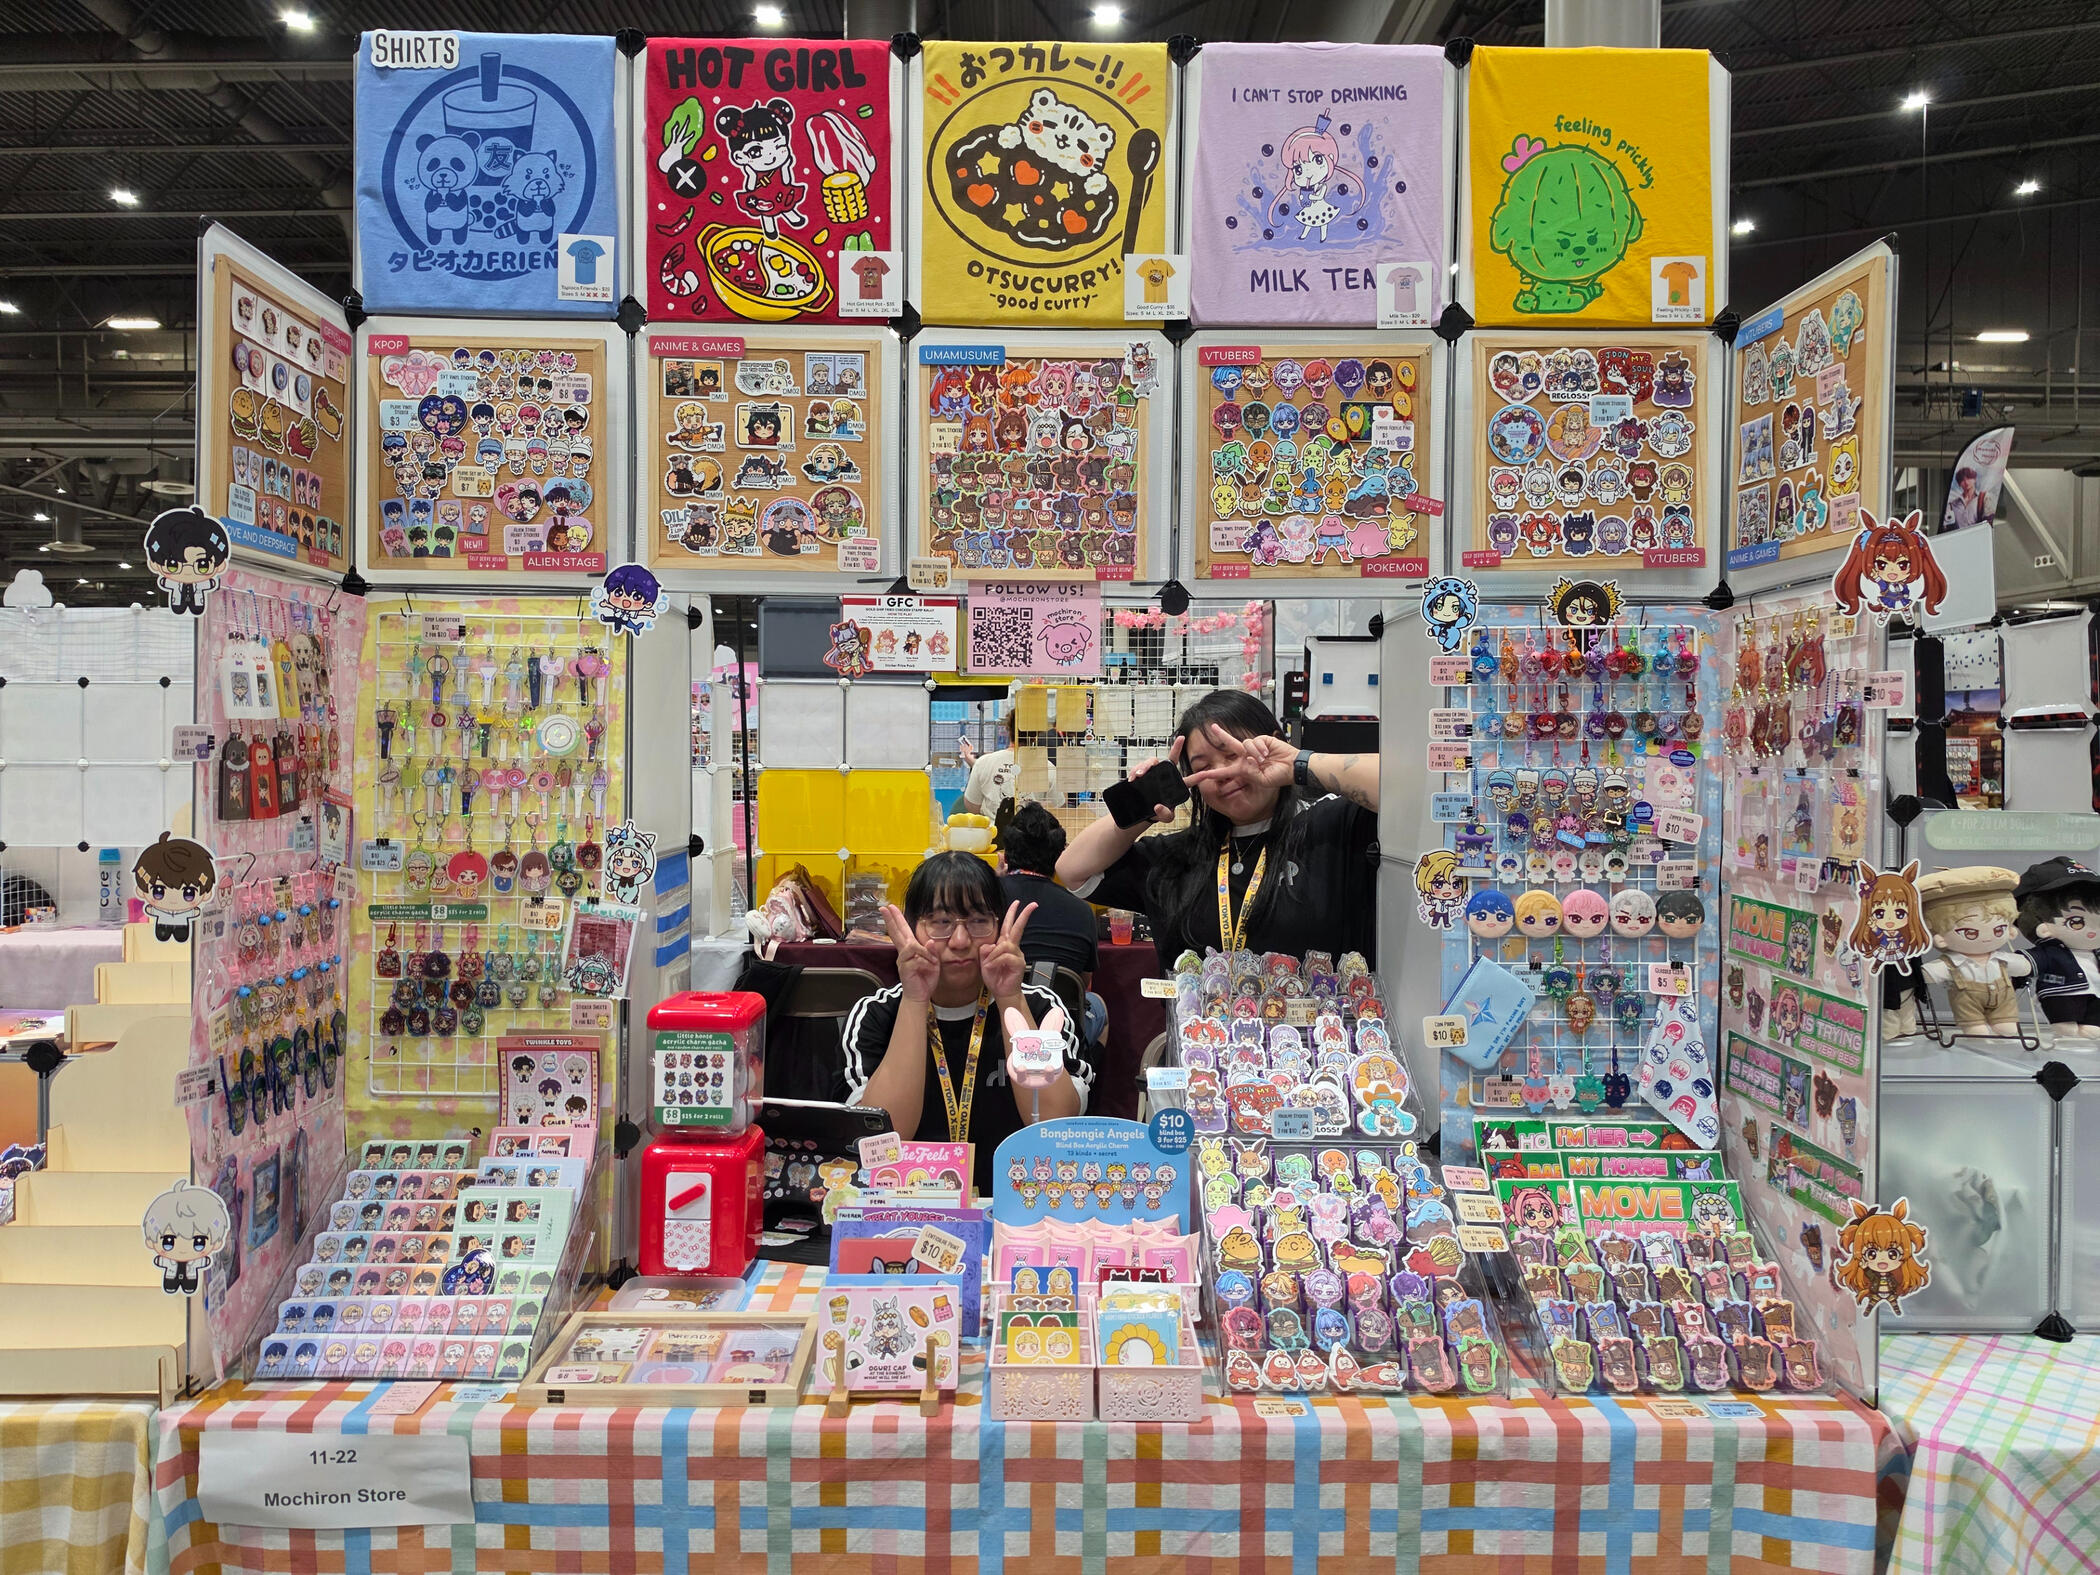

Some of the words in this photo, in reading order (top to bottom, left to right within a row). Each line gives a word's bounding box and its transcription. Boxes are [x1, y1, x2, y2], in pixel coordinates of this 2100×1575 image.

[375, 33, 456, 65] SHIRTS
[665, 48, 755, 89] HOT
[765, 48, 867, 92] GIRL
[1232, 88, 1237, 103] I
[1243, 87, 1281, 103] CAN'T
[1288, 90, 1323, 104] STOP
[1331, 85, 1408, 104] DRINKING
[1553, 114, 1613, 147] feeling
[484, 143, 514, 173] 友
[966, 259, 1122, 297] OTSUCURRY!
[1250, 268, 1310, 293] MILK
[1321, 267, 1377, 291] TEA
[374, 340, 404, 350] KPOP
[654, 342, 689, 352] ANIME
[692, 342, 699, 351] &
[702, 342, 741, 352] GAMES
[925, 350, 1000, 361] UMAMUSUME
[1204, 351, 1255, 361] VTUBERS
[1631, 355, 1645, 363] MY
[559, 389, 569, 399] $8
[1552, 392, 1592, 400] REGLOSS!
[390, 416, 400, 426] $3
[461, 484, 470, 492] $7
[662, 510, 691, 525] DILF
[226, 525, 241, 539] OVE
[243, 530, 258, 543] AND
[260, 534, 296, 554] DEEPSPACE
[464, 540, 483, 549] NEW!!
[528, 558, 560, 567] ALIEN
[563, 558, 599, 567] STAGE
[1651, 554, 1700, 563] VTUBERS
[1729, 550, 1747, 565] ANIME
[1754, 547, 1777, 561] GAMES
[1367, 562, 1423, 573] POKEMON
[985, 584, 1051, 596] FOLLOW
[1058, 584, 1084, 597] US!
[887, 597, 914, 608] GFC
[1047, 608, 1082, 619] mochiron
[1665, 823, 1680, 834] $10
[100, 870, 111, 908] core
[434, 906, 445, 915] $8
[608, 910, 638, 921] LOVE
[202, 920, 213, 933] $10
[1732, 900, 1786, 943] MOVE
[1744, 934, 1785, 963] HUNGRY
[1658, 978, 1668, 988] $5
[1802, 992, 1823, 1014] MY
[1822, 999, 1865, 1033] HORSE
[1432, 1031, 1447, 1041] $10
[1801, 1013, 1815, 1034] IS
[1816, 1019, 1863, 1053] TRYING
[1838, 1048, 1861, 1068] BEST
[1730, 1056, 1741, 1074] IS
[1740, 1060, 1782, 1096] FASTER
[1258, 1087, 1270, 1095] MY
[944, 1087, 957, 1118] TOKYO
[1261, 1096, 1282, 1104] SOUL
[666, 1110, 678, 1119] $8
[1160, 1114, 1185, 1129] $10
[958, 1110, 968, 1142] TOKYO
[1040, 1128, 1105, 1141] Bongbongie
[1107, 1128, 1145, 1142] Angels
[1174, 1136, 1188, 1144] $25
[1556, 1126, 1584, 1147] I'M
[1587, 1126, 1628, 1148] HER
[915, 1146, 950, 1163] Feels
[1568, 1157, 1600, 1176] MY
[1602, 1156, 1668, 1177] HORSE
[1580, 1185, 1684, 1219] MOVE
[864, 1211, 898, 1221] TREAT
[1584, 1219, 1612, 1239] I'M
[1614, 1220, 1688, 1238] HUNGRY
[920, 1240, 940, 1259] $10
[310, 1450, 358, 1465] 11-22
[264, 1490, 351, 1507] Mochiron
[358, 1488, 407, 1504] Store
